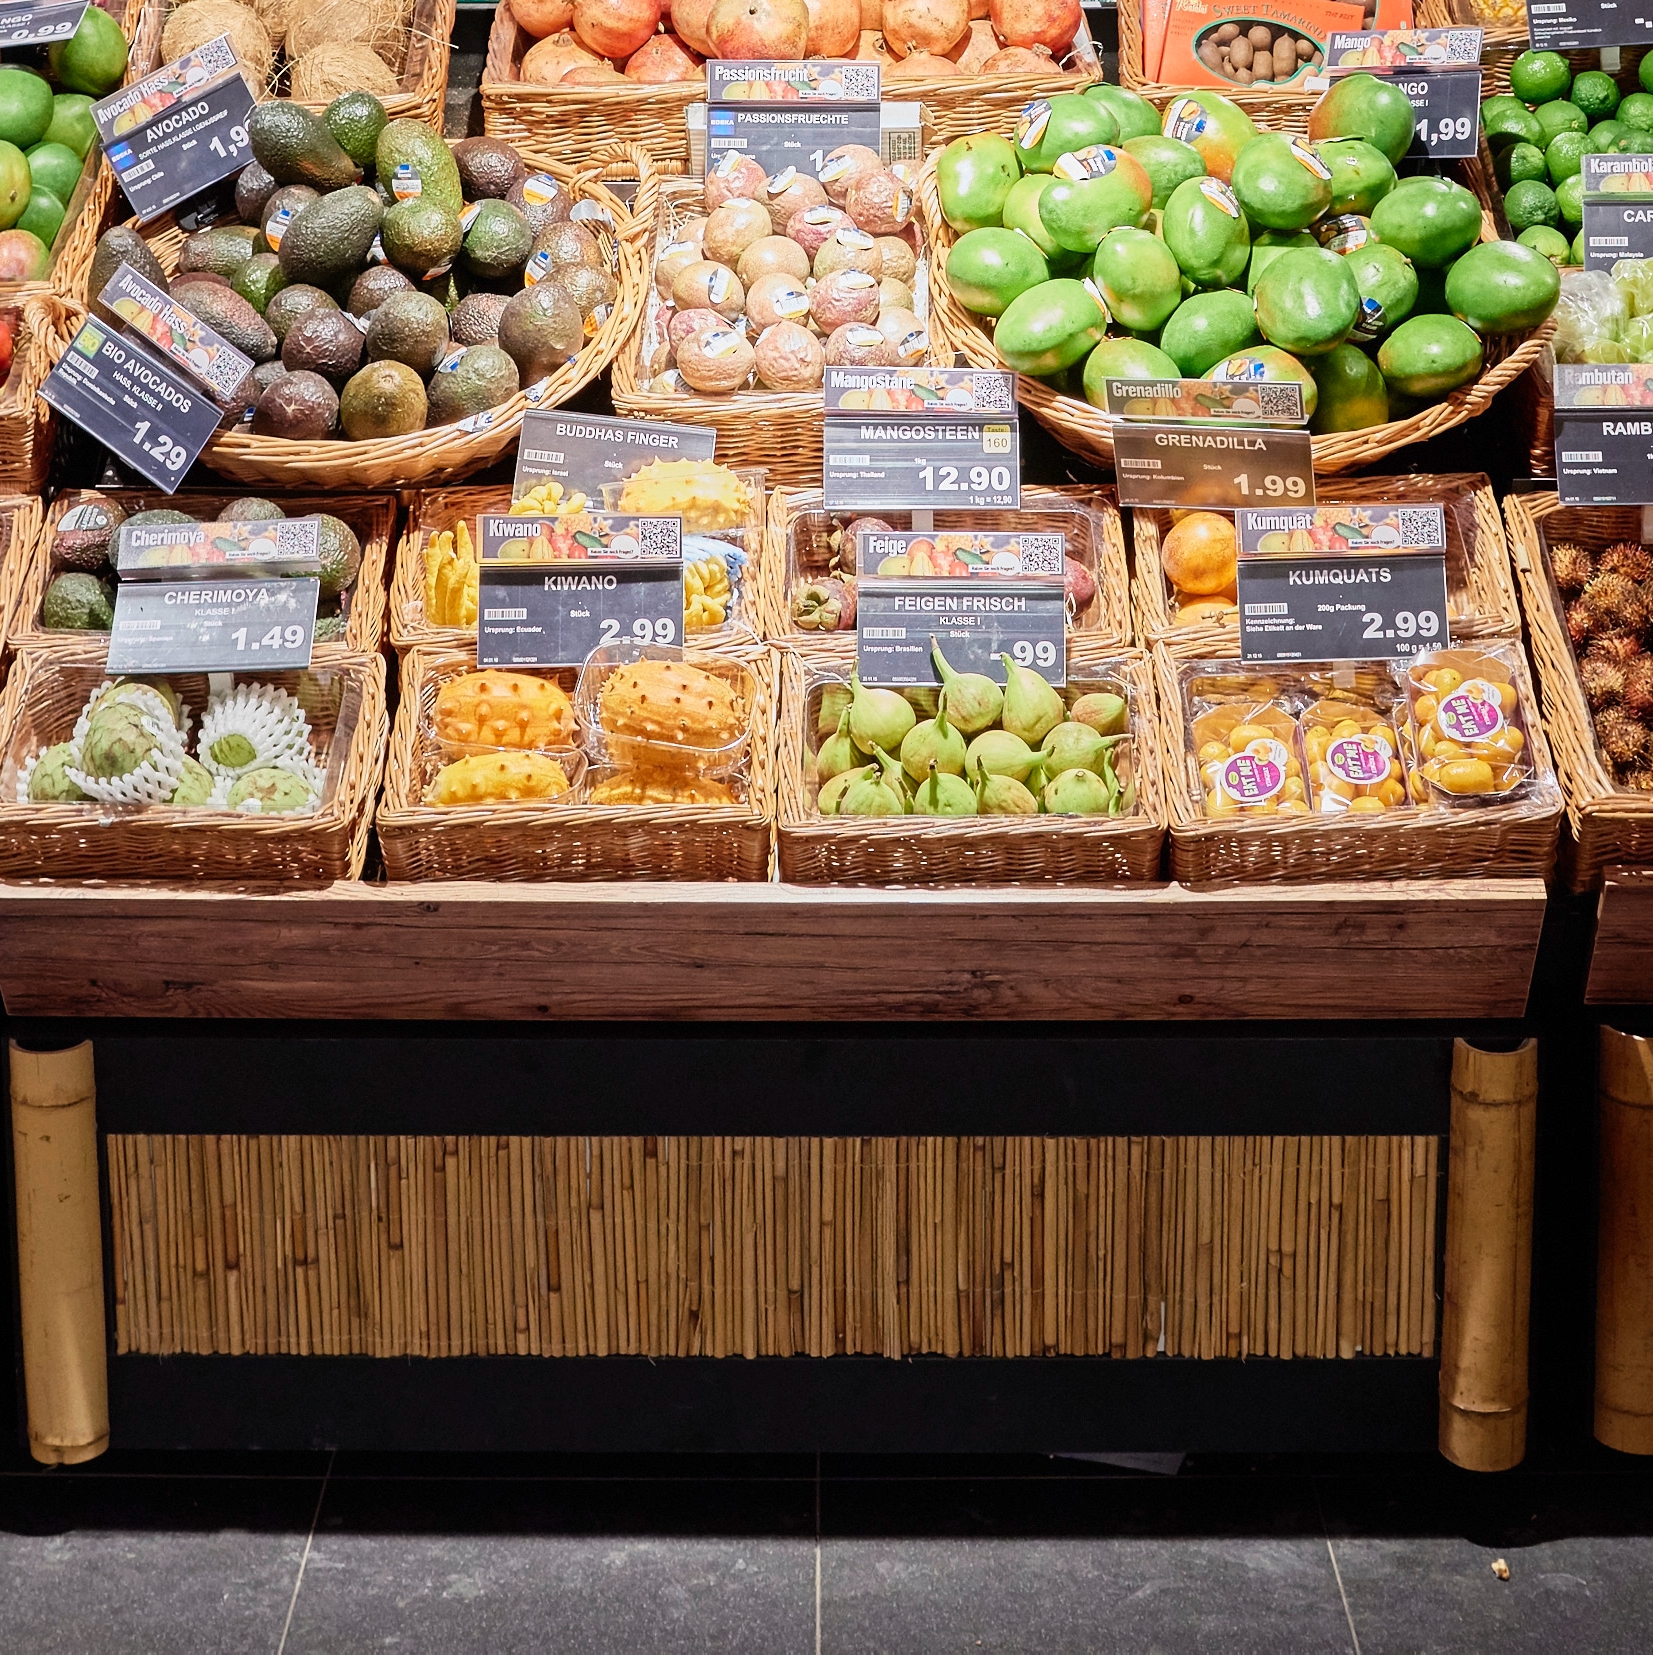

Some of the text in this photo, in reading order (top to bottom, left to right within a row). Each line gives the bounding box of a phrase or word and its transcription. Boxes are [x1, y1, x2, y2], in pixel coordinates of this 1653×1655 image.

[1213, 3, 1326, 39] SWEET TAMARIND
[1334, 35, 1370, 50] Mango
[714, 65, 809, 83] Passionsfrucht
[98, 75, 168, 125] Avocado Hass
[147, 101, 210, 143] AVOCADO
[738, 113, 848, 125] PASSIONSFRUECHTE
[1415, 118, 1472, 143] 1,99
[118, 272, 190, 333] Avocado Hass
[101, 340, 193, 414] BIO AVOCADOS
[831, 371, 914, 390] Mangostane
[1564, 368, 1633, 387] Rambutan
[1112, 382, 1181, 398] Grenadillo
[556, 423, 678, 448] BUDDHAS FINGER
[860, 426, 979, 440] MANGOSTEEN
[1155, 434, 1266, 450] GRENADILLA
[133, 419, 188, 472] 1.29
[986, 438, 1008, 448] 160
[918, 466, 1011, 491] 12.90
[1233, 474, 1306, 498] 1.99
[489, 520, 541, 537] Kiwano
[1247, 513, 1312, 531] Kumquat
[131, 527, 205, 547] Cherimoya
[868, 537, 906, 557] Feige
[544, 576, 616, 591] KIWANO
[1289, 568, 1391, 585] KUMQUATS
[164, 588, 269, 606] CHERIMOYA
[894, 597, 1025, 611] FEIGEN FRISCH
[1317, 603, 1365, 613] 200g Packung
[939, 616, 975, 625] KLASSE
[1362, 610, 1439, 639] 2.99
[231, 625, 305, 652] 1.49
[600, 617, 675, 645] 2.99
